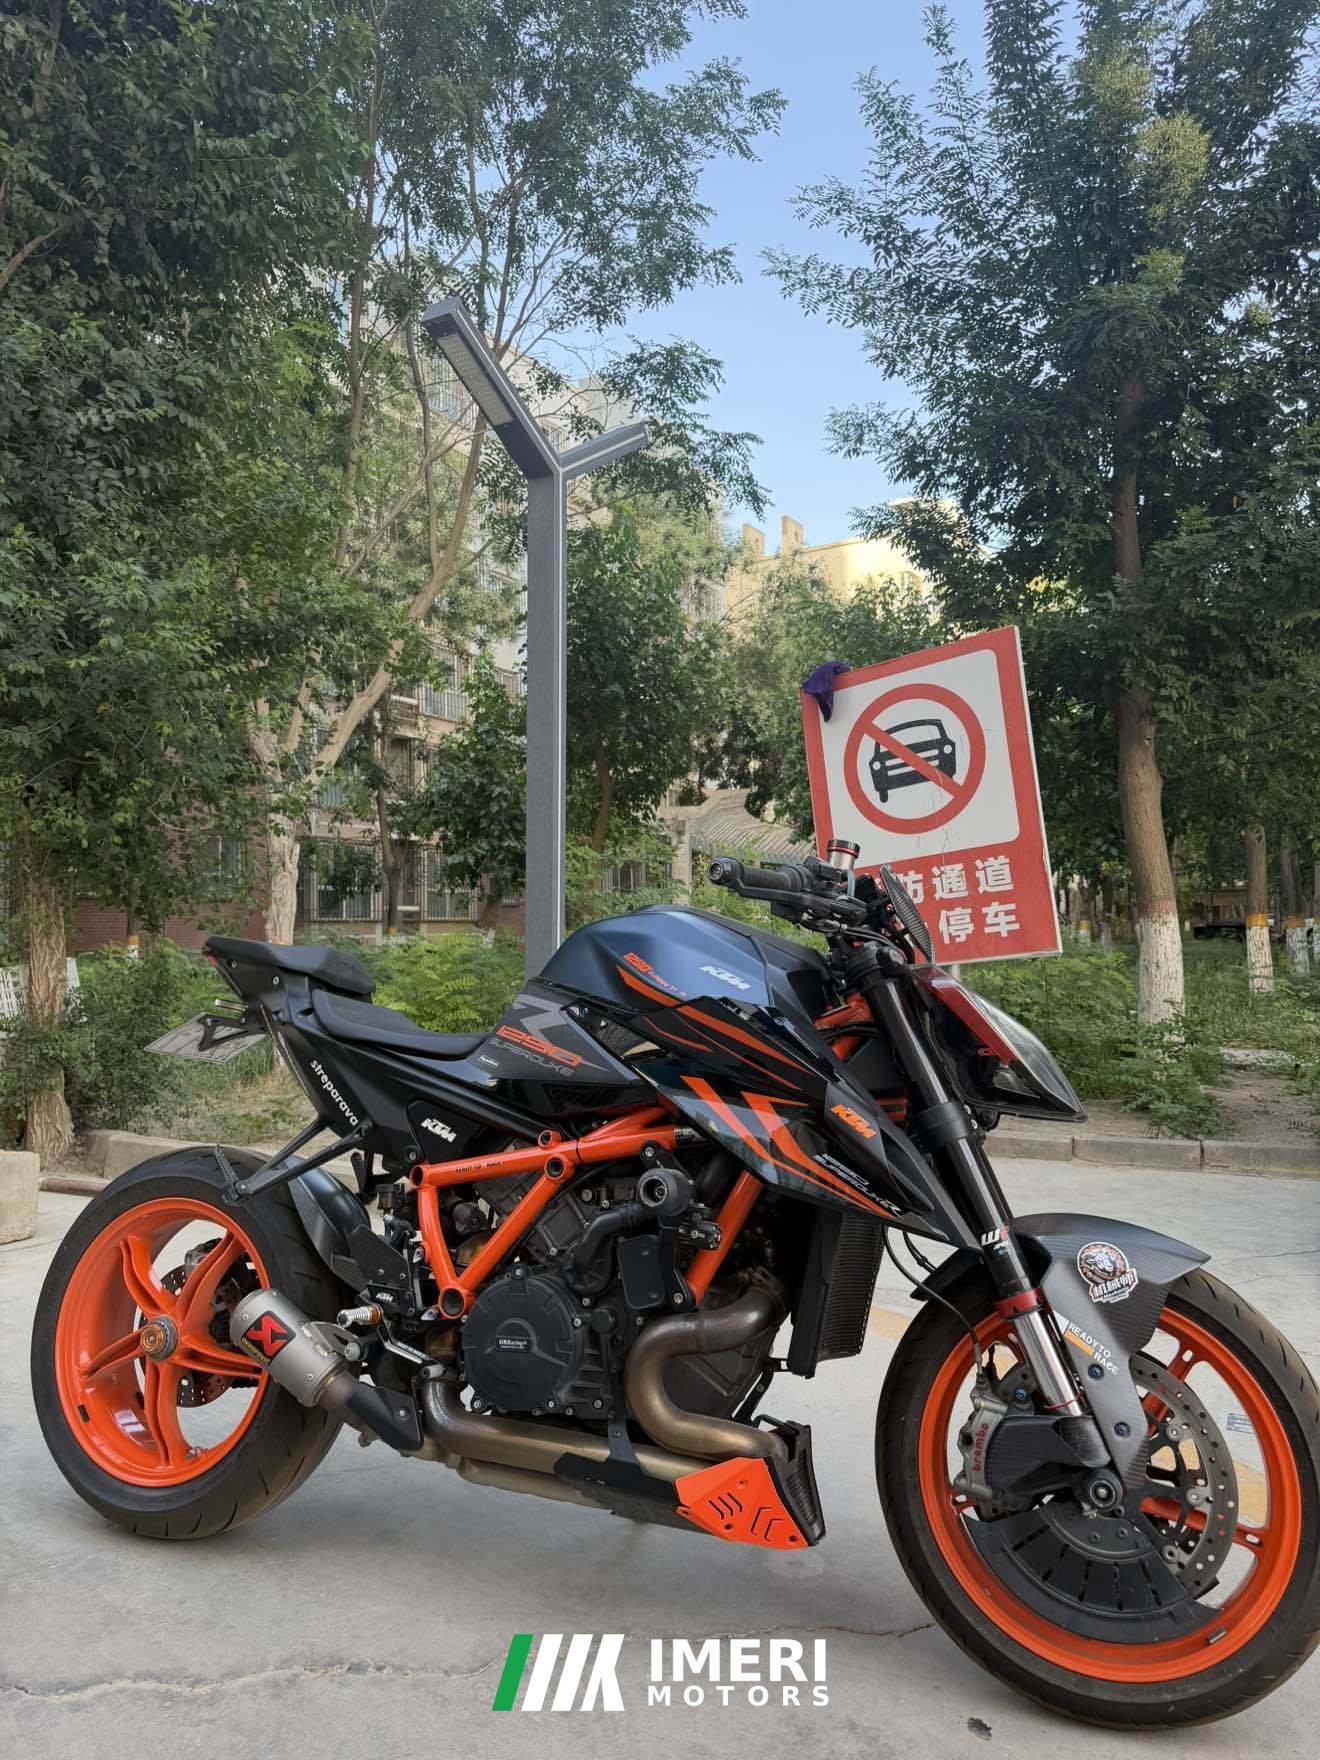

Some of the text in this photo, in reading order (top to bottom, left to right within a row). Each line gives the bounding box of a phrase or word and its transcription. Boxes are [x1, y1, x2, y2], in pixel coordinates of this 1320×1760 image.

[892, 855, 1015, 905] 防通道
[699, 965, 751, 991] KTM
[310, 1059, 360, 1127] streparava
[420, 1117, 457, 1143] KTM
[831, 1104, 877, 1139] KTM
[1067, 1322, 1111, 1359] READY TO
[1093, 1352, 1120, 1376] RACE
[971, 1423, 990, 1473] brembo
